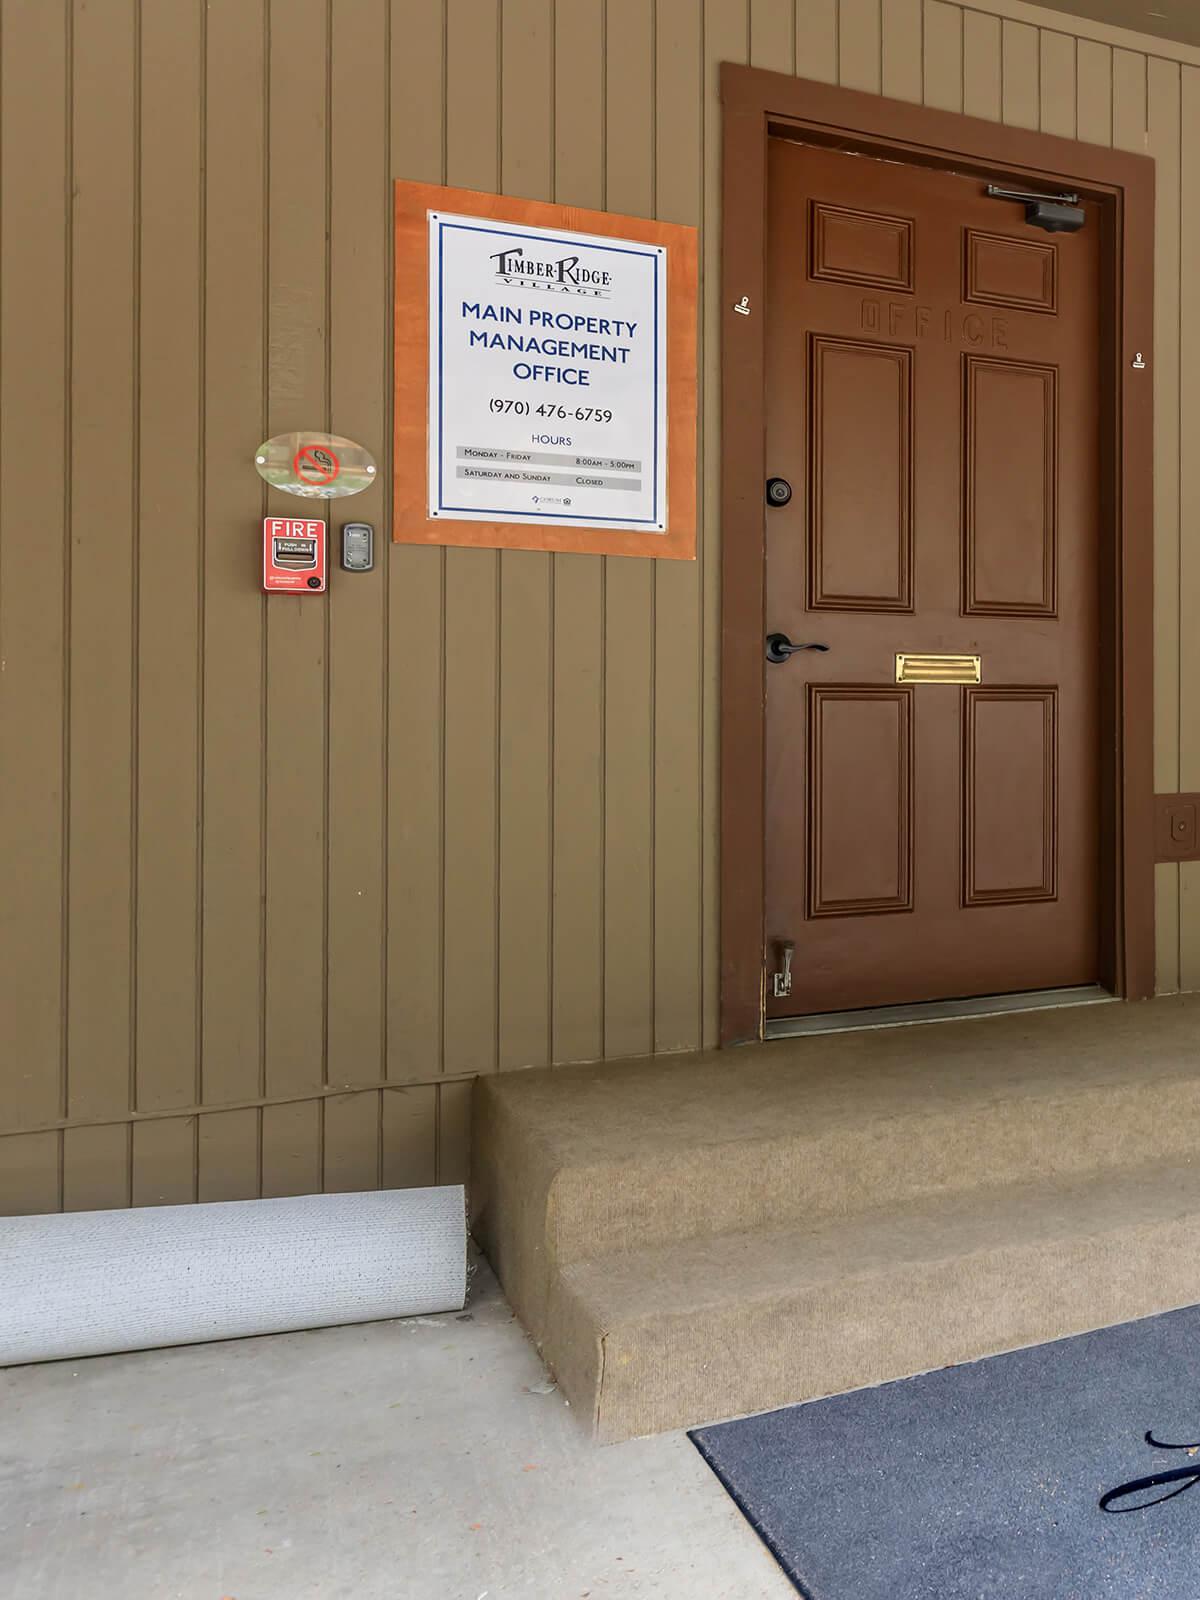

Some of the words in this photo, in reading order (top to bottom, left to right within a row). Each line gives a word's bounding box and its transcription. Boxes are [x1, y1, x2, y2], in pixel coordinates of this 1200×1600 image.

[503, 278, 602, 296] VILLAGE
[462, 302, 522, 324] MAIN
[529, 310, 637, 338] PROPERTY
[860, 299, 1009, 351] OFFICE
[469, 330, 631, 364] MANAGEMENT
[513, 363, 590, 386] OFFICE
[489, 398, 530, 417] (970)
[535, 404, 613, 424] 476-6759
[531, 434, 572, 447] HOURS
[272, 521, 318, 537] FIRE
